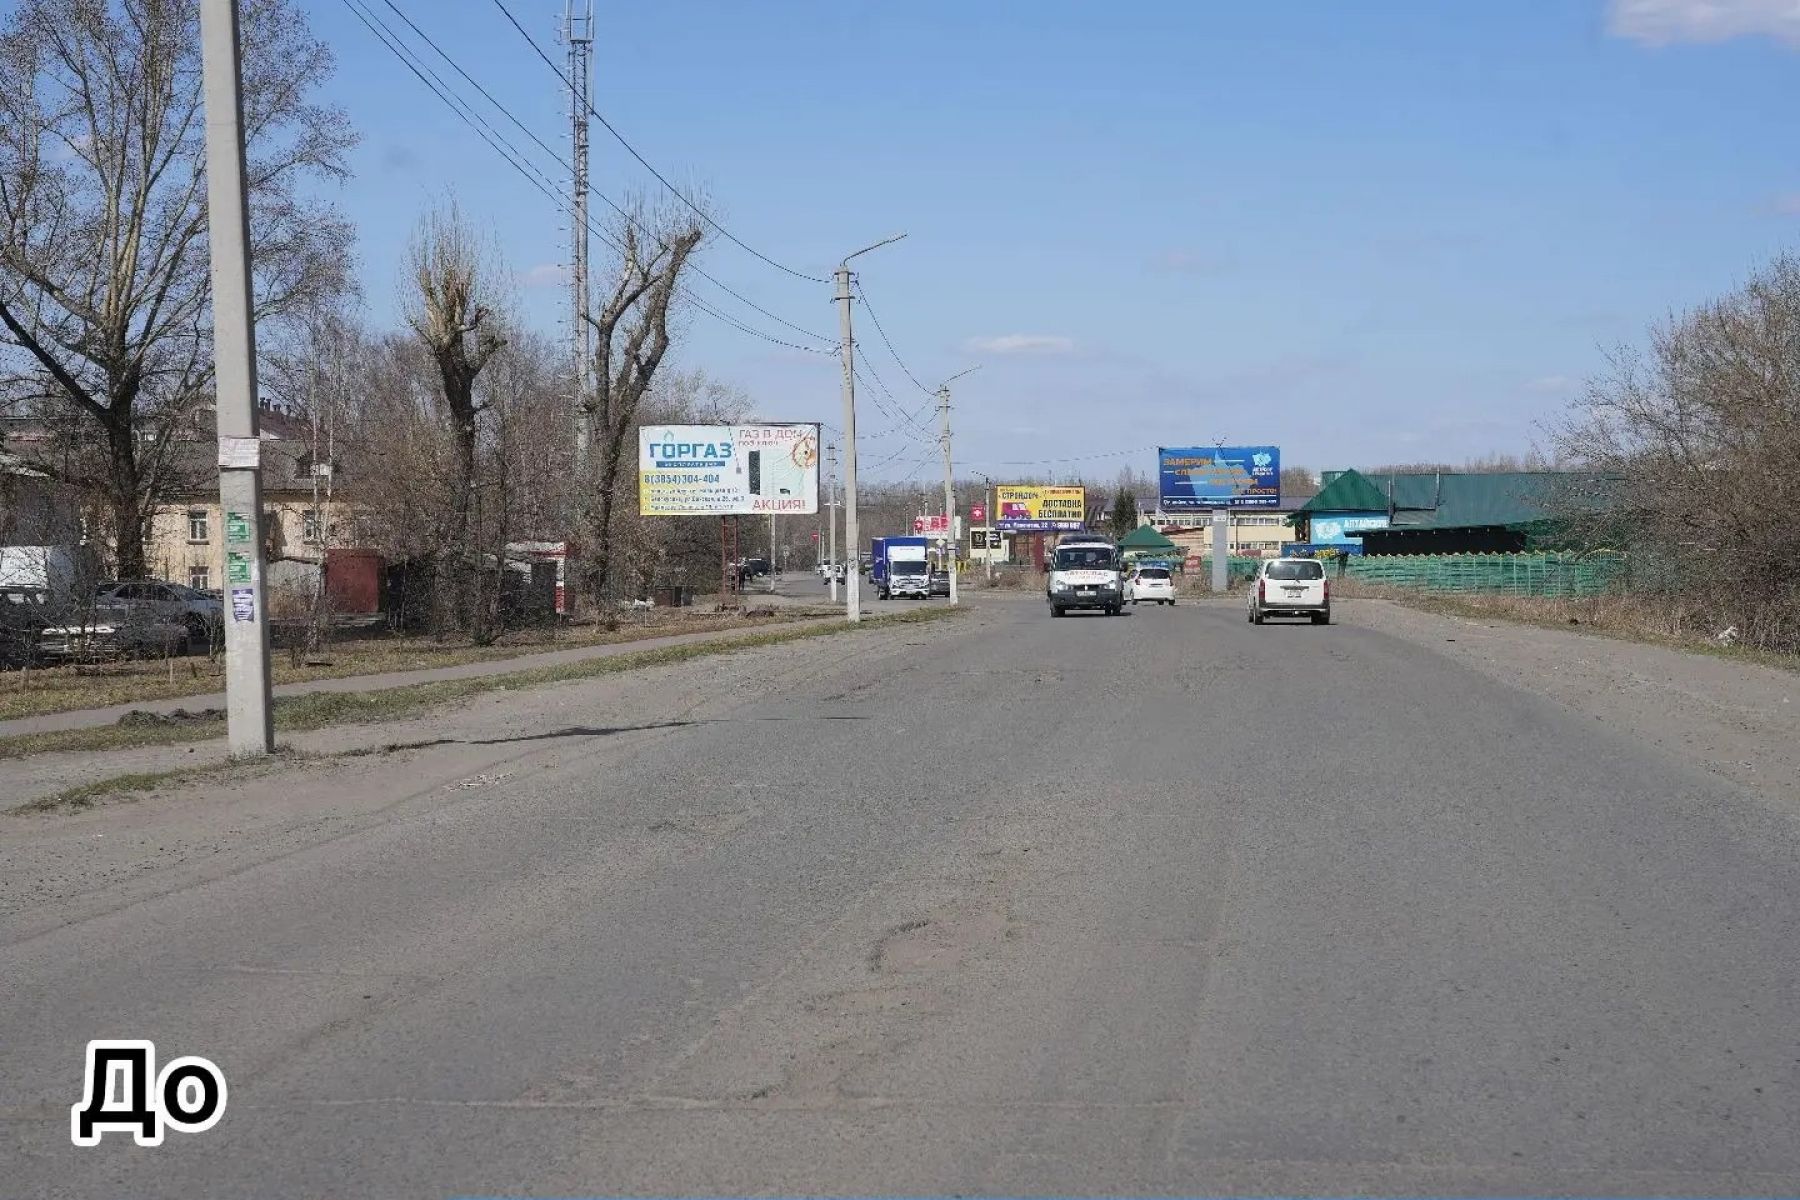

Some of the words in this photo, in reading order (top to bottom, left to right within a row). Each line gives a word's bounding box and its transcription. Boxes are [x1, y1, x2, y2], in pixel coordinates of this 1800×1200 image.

[649, 442, 732, 459] ГОРГАЗ
[752, 499, 806, 511] АКЦИЯ!
[1042, 499, 1082, 509] ДОСТАВКА
[1038, 510, 1082, 519] БЕСПЛАТНО
